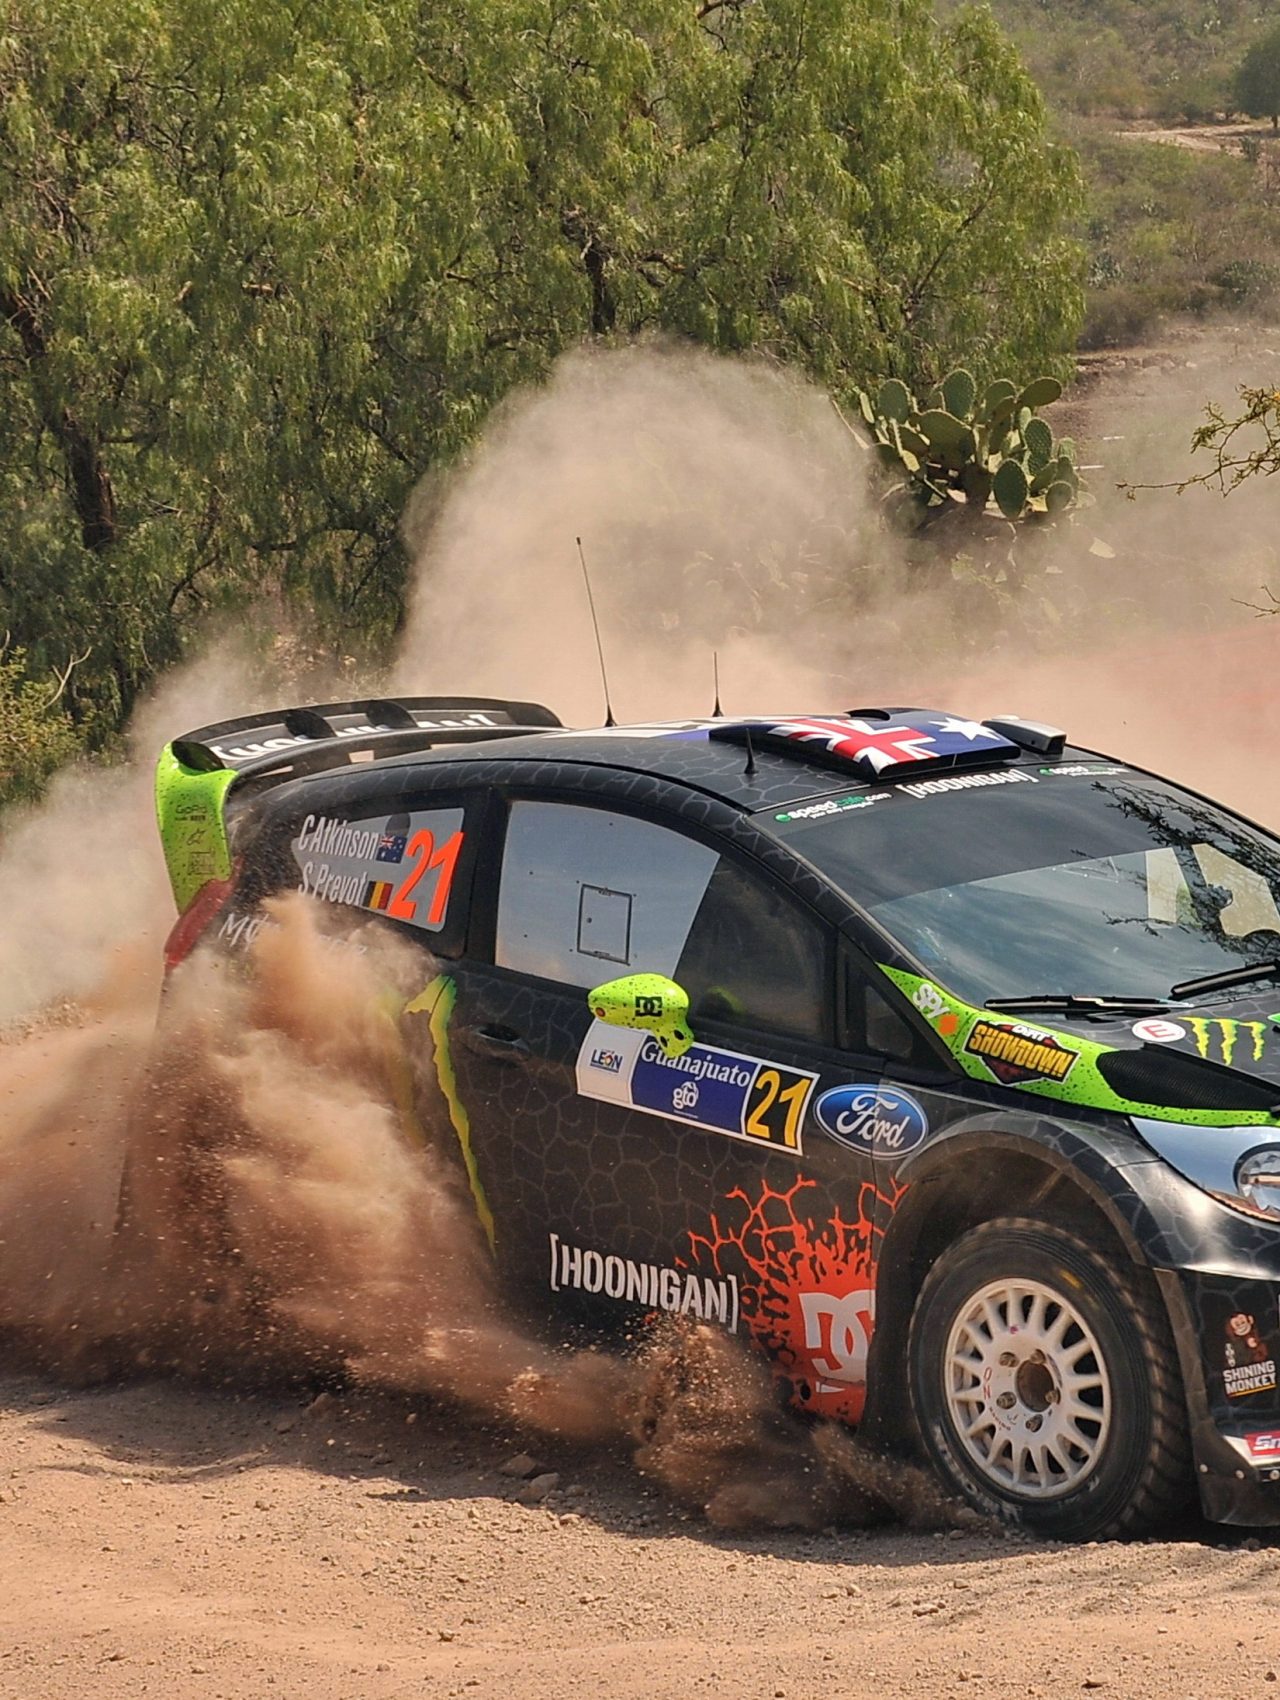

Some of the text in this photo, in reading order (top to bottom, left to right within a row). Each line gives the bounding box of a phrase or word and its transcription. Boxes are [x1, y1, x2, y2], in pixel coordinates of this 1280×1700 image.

[313, 864, 368, 906] Prevot
[387, 828, 465, 924] 21
[641, 1042, 751, 1087] Guanajuato
[747, 1070, 811, 1147] 21
[836, 1093, 911, 1148] Ford
[1223, 1360, 1276, 1382] SHINING
[1225, 1372, 1277, 1394] MONKEY
